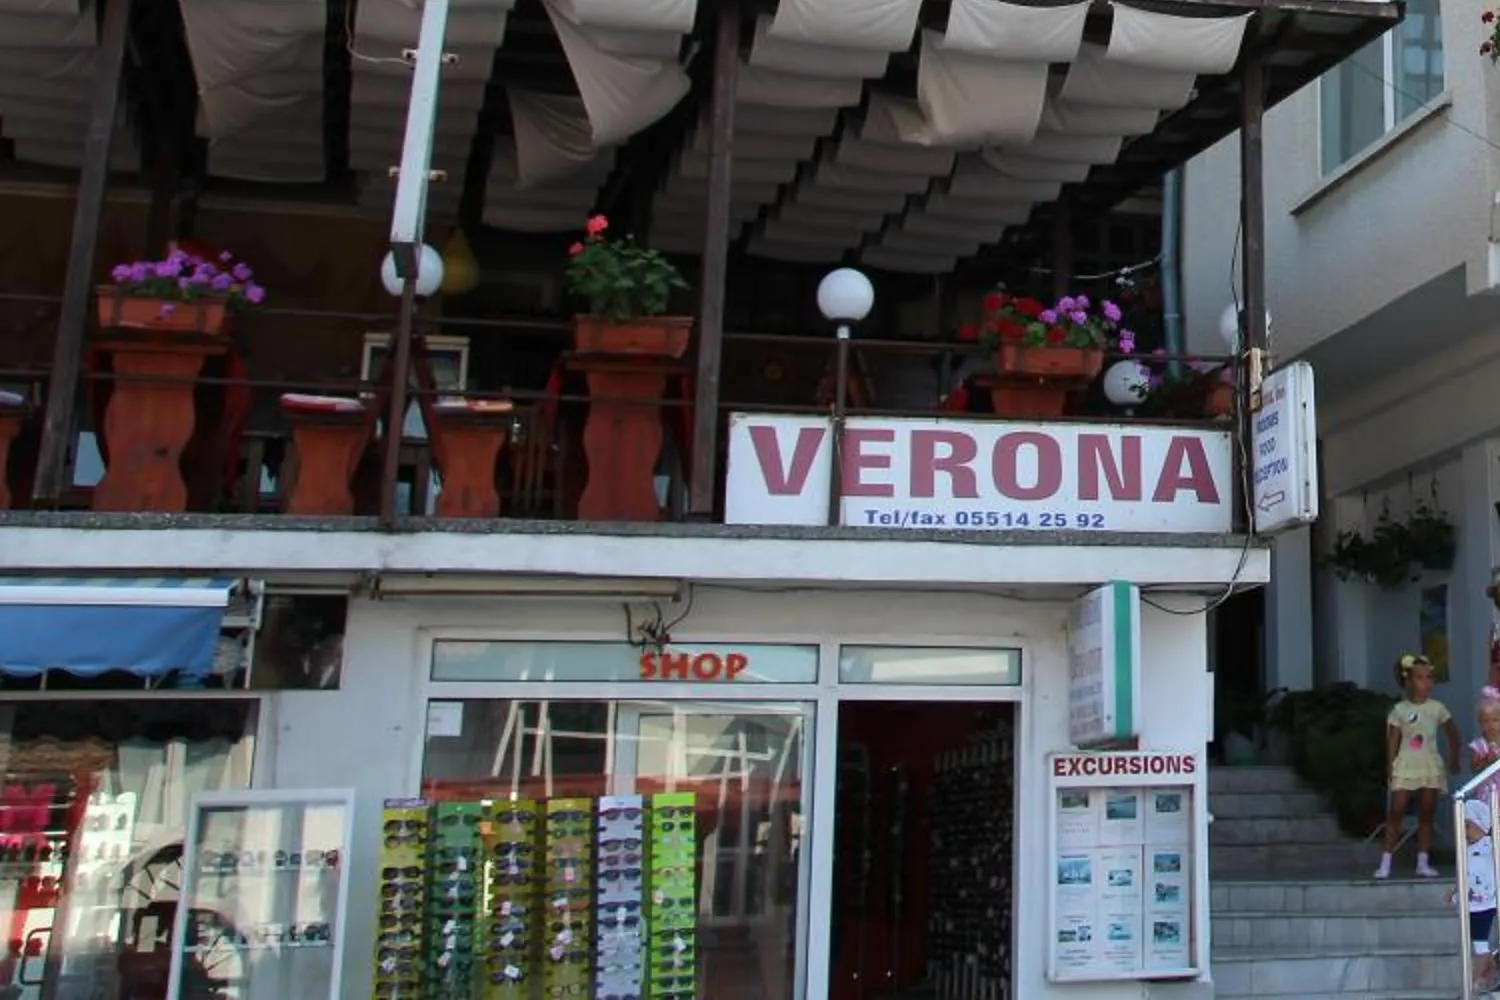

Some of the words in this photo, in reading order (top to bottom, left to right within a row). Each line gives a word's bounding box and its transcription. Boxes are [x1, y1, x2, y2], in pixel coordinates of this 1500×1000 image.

[748, 425, 1221, 505] VERONA
[865, 508, 946, 527] Tel/fax
[954, 510, 1030, 528] 05514
[1039, 511, 1068, 528] 25
[1075, 512, 1106, 529] 92
[640, 652, 749, 681] SHOP
[1053, 756, 1196, 777] EXCURSIONS
